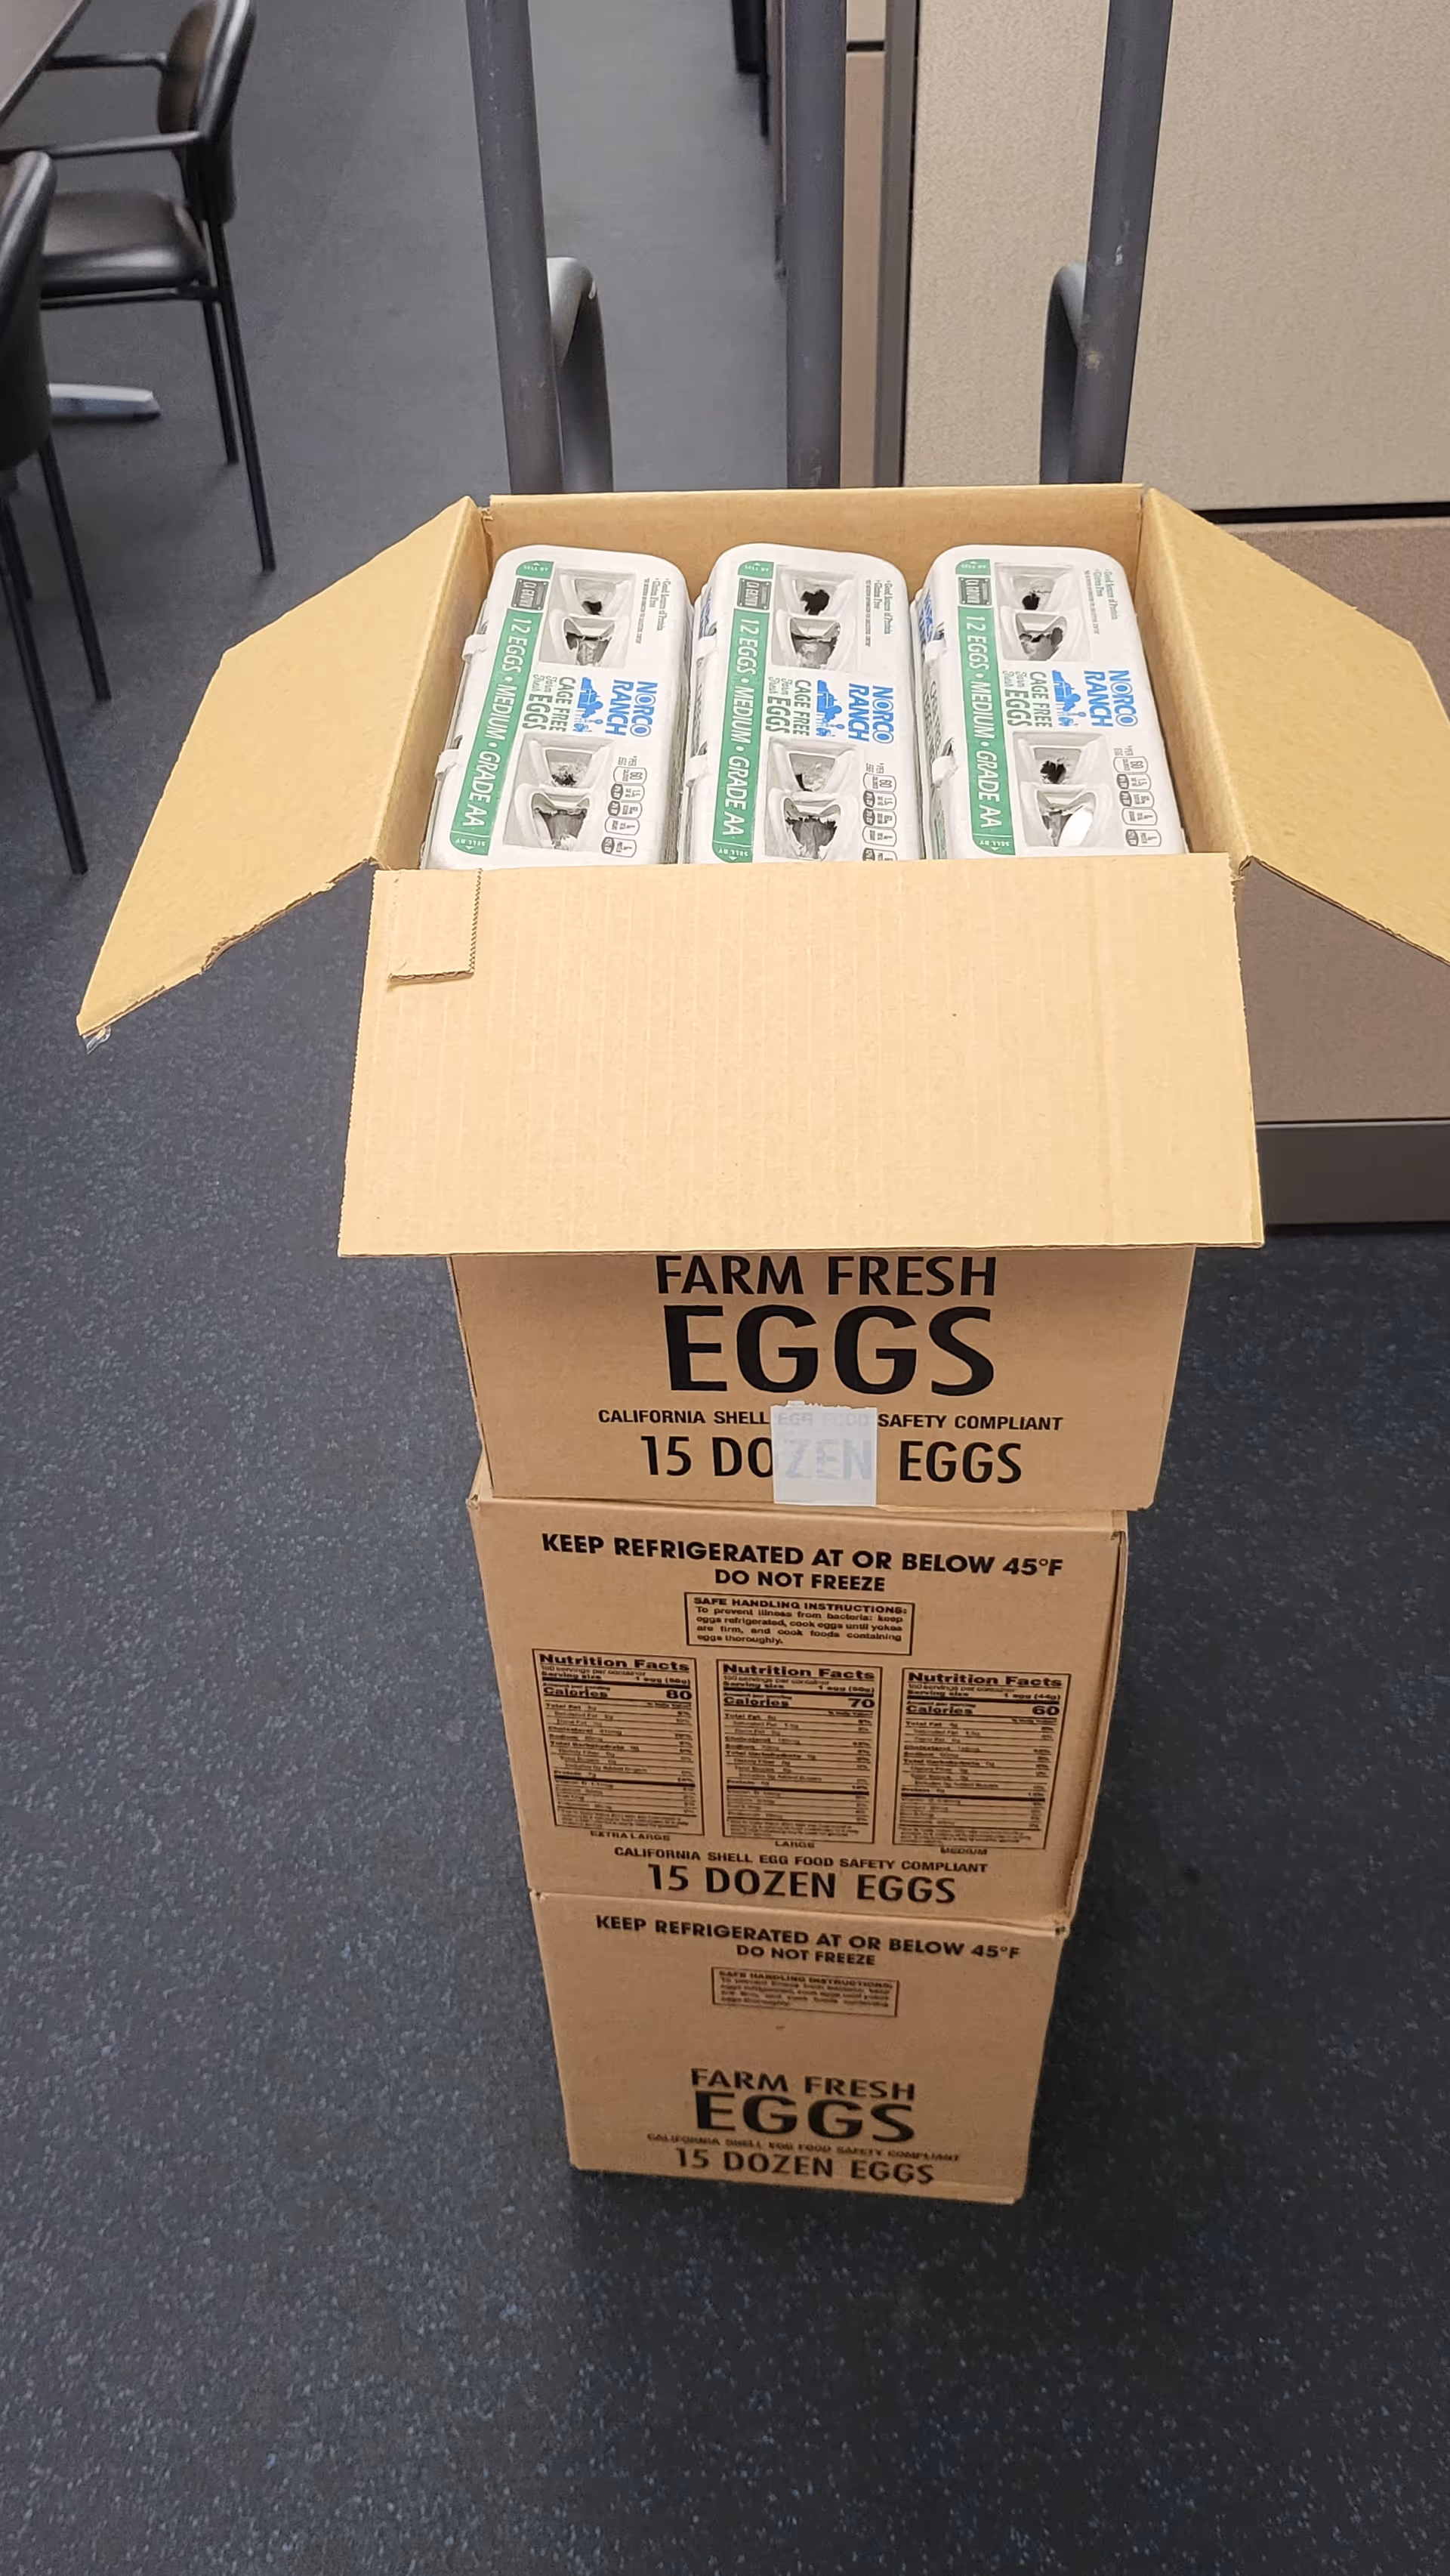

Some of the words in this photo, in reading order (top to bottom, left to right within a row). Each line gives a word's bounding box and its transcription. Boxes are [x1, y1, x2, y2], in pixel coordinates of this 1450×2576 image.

[511, 618, 532, 634] 12
[740, 619, 760, 635] 12
[966, 616, 986, 631] 12
[502, 636, 528, 673] EGGS
[736, 638, 758, 676] EGGS
[967, 635, 989, 670] EGGS
[555, 676, 576, 705] CAGE
[794, 679, 812, 709] CAGE
[1029, 671, 1049, 700] CAGE
[1084, 670, 1113, 727] RANCH
[1109, 670, 1138, 727] NORCO
[485, 684, 517, 740] MEDIUM
[522, 693, 553, 730] EGGS
[549, 707, 570, 732] FREE
[605, 679, 634, 736] RANCH
[630, 681, 658, 737] NORCO
[730, 686, 754, 743] MEDIUM
[766, 696, 791, 734] EGGS
[848, 683, 870, 742] RANCH
[872, 685, 894, 744] NORCO
[970, 681, 995, 739] MEDIUM
[1004, 689, 1032, 726] EGGS
[1033, 703, 1052, 727] FREE
[793, 709, 810, 737] FREE
[468, 751, 501, 804] GRADE
[725, 756, 750, 810] GRADE
[976, 751, 1000, 802] GRADE
[462, 804, 487, 826] AA
[723, 811, 745, 836] AA
[979, 805, 1002, 828] AA
[656, 1255, 804, 1295] FARM
[828, 1256, 996, 1296] FRESH
[663, 1304, 995, 1396] EGGS
[598, 1409, 706, 1424] CALIFORNIA
[714, 1410, 770, 1425] SHELL
[878, 1413, 946, 1429] SAFETY
[954, 1415, 1063, 1431] COMPLIANT
[640, 1435, 692, 1476] 15
[899, 1439, 1022, 1484] EGGS
[541, 1533, 604, 1555] KEEP
[613, 1537, 804, 1566] REFRIGERATED
[811, 1548, 844, 1567] AT
[852, 1550, 892, 1570] OR
[902, 1552, 995, 1574] BELOW
[1001, 1557, 1063, 1577] 45°F
[714, 1568, 751, 1586] DO
[757, 1571, 804, 1588] NOT
[810, 1574, 886, 1592] FREEZE
[693, 1597, 727, 1605] SAFE
[732, 1598, 800, 1609] HANDLING
[804, 1602, 907, 1614] INSTRUCTIONS:
[714, 1608, 754, 1616] prevent
[758, 1609, 792, 1617] illness
[797, 1611, 822, 1619] from
[827, 1612, 872, 1621] bacteria:
[878, 1614, 903, 1623] keep
[720, 1626, 744, 1634] firm,
[810, 1629, 840, 1638] foods
[847, 1632, 902, 1642] containing
[724, 1617, 787, 1627] refrigerated,
[725, 1635, 783, 1645] thoroughly.
[539, 1654, 628, 1667] Nutrition
[634, 1659, 690, 1671] Facts
[723, 1663, 812, 1677] Nutrition
[819, 1668, 875, 1679] Facts
[543, 1687, 608, 1698] Calories
[666, 1689, 693, 1700] 80
[909, 1672, 998, 1685] Nutrition
[1005, 1676, 1063, 1687] Facts
[723, 1696, 789, 1707] Calories
[847, 1697, 875, 1709] 70
[906, 1704, 973, 1716] Calories
[1032, 1705, 1060, 1716] 60
[591, 1830, 628, 1839] EXTRA
[631, 1833, 671, 1842] LARGE
[775, 1840, 815, 1849] LARGE
[615, 1846, 701, 1861] CALIFORNIA
[708, 1852, 754, 1864] SHELL
[759, 1854, 788, 1865] EGG
[794, 1855, 834, 1867] FOOD
[839, 1858, 895, 1870] SAFETY
[901, 1860, 989, 1873] COMPLIANT
[940, 1847, 988, 1855] MEDIUM
[648, 1863, 689, 1892] 15
[705, 1867, 835, 1898] DOZEN
[857, 1873, 955, 1904] EGGS
[596, 1915, 646, 1931] KEEP
[655, 1920, 809, 1944] REFRIGERATED
[816, 1932, 842, 1947] AT
[849, 1935, 881, 1951] OR
[889, 1938, 965, 1956] BELOW
[970, 1944, 1020, 1959] 45°F
[736, 1944, 764, 1957] DO
[771, 1947, 810, 1961] NOT
[815, 1950, 875, 1966] FREEZE
[691, 2068, 788, 2092] FARM
[804, 2076, 915, 2101] FRESH
[696, 2090, 915, 2142] EGGS
[647, 2133, 720, 2145] CALIFORNIA
[798, 2143, 831, 2152] FOOD
[836, 2146, 882, 2156] SAFETY
[887, 2150, 959, 2161] COMPLIANT
[675, 2147, 709, 2169] 15
[723, 2151, 832, 2177] DOZEN
[851, 2159, 934, 2184] EGGS
